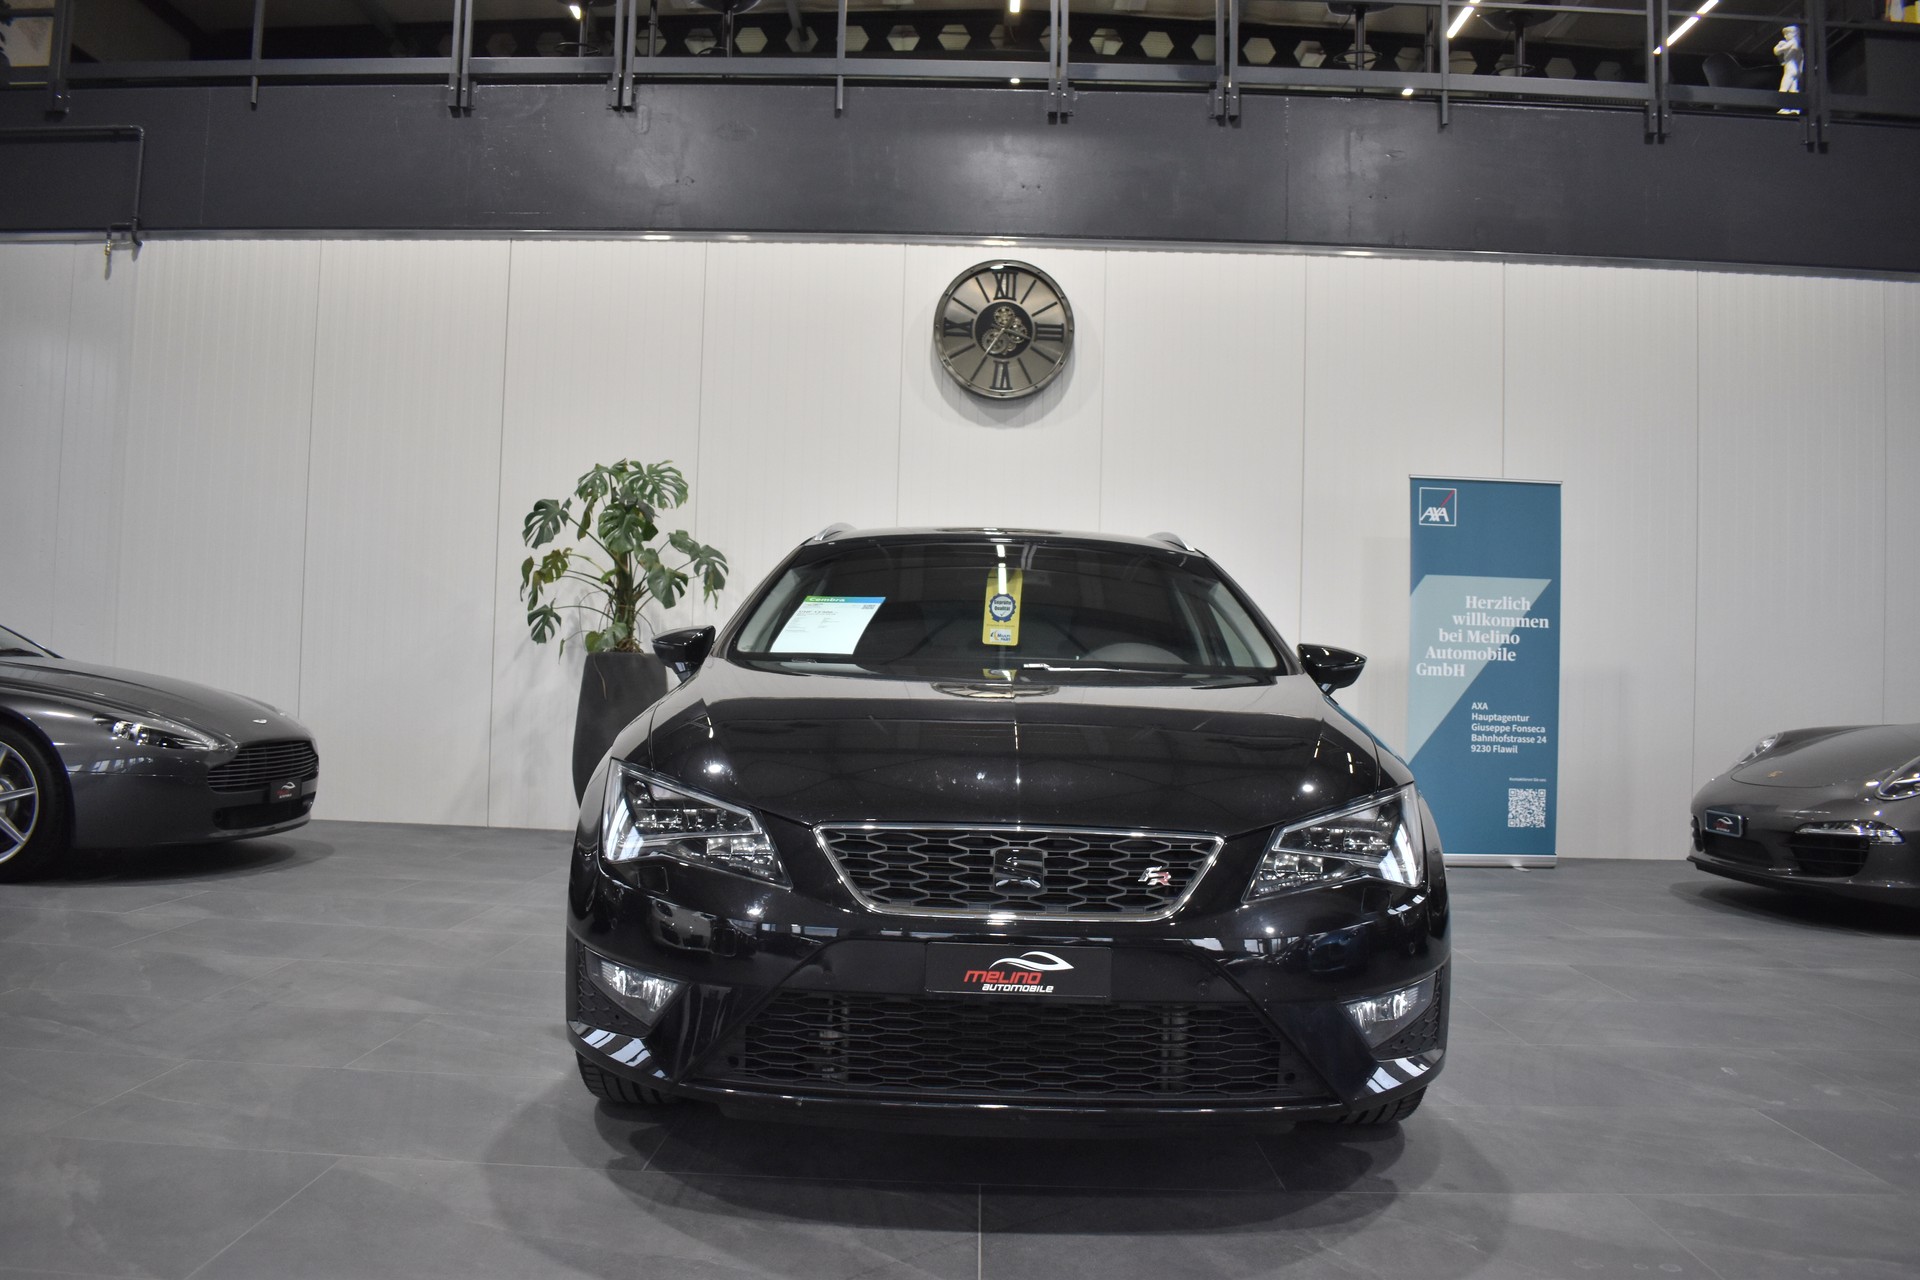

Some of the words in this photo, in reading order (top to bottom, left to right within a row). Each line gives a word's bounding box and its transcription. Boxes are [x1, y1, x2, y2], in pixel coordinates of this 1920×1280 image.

[1420, 506, 1450, 522] AXA
[1465, 595, 1531, 611] Herzlich
[1452, 611, 1550, 628] willkommen
[1438, 628, 1463, 643] bei
[1466, 629, 1521, 645] Melino
[1425, 645, 1517, 662] Automobile
[1415, 663, 1466, 677] GmbH
[1471, 702, 1488, 710] AXA
[1471, 712, 1530, 723] Hauptagentur
[1471, 723, 1511, 733] Giuseppe
[1512, 724, 1546, 733] Fonseca
[1471, 733, 1536, 743] Bahnhofstrasse
[1536, 736, 1547, 744] 24
[1470, 744, 1492, 753] 9230
[1492, 745, 1518, 754] Flawil
